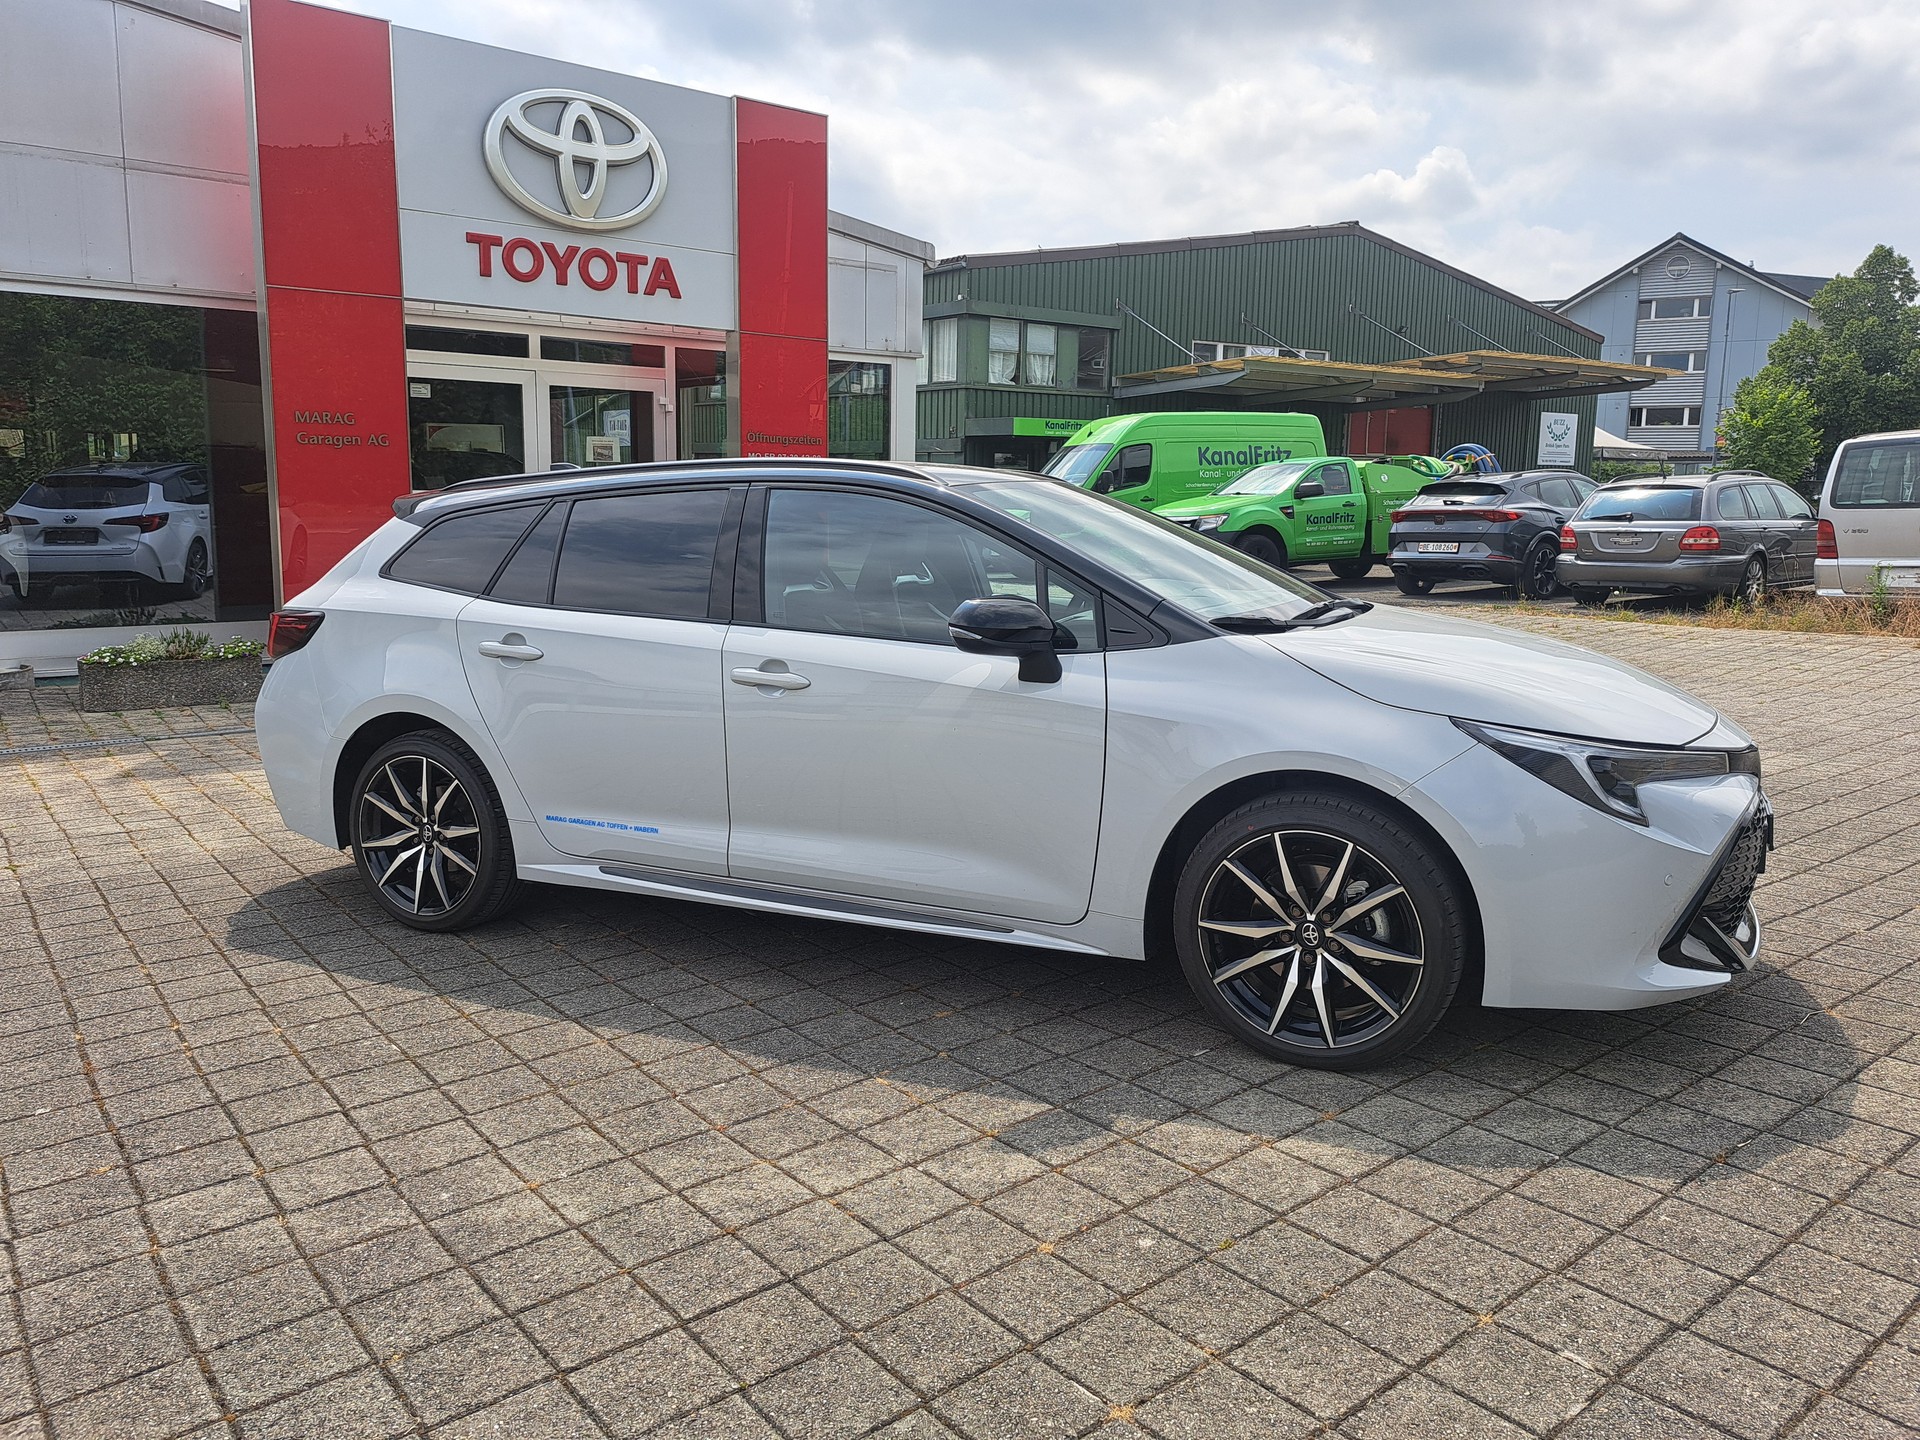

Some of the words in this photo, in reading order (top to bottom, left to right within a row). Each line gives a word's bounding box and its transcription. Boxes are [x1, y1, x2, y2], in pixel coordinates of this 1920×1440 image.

[466, 231, 682, 299] TOYOTA
[295, 411, 355, 425] MARAG
[1045, 420, 1083, 431] KanalFritz
[296, 431, 361, 448] Garagen
[367, 434, 389, 446] AG
[747, 430, 823, 447] Öffnungszeiten
[1197, 445, 1292, 466] KanalFritz
[1199, 469, 1225, 478] Kanal-
[1306, 512, 1356, 525] KanalFritz
[545, 815, 567, 823] MARAG
[568, 817, 596, 827] GARAGEN
[606, 822, 628, 830] TOFFEN
[633, 825, 659, 834] WABERN
